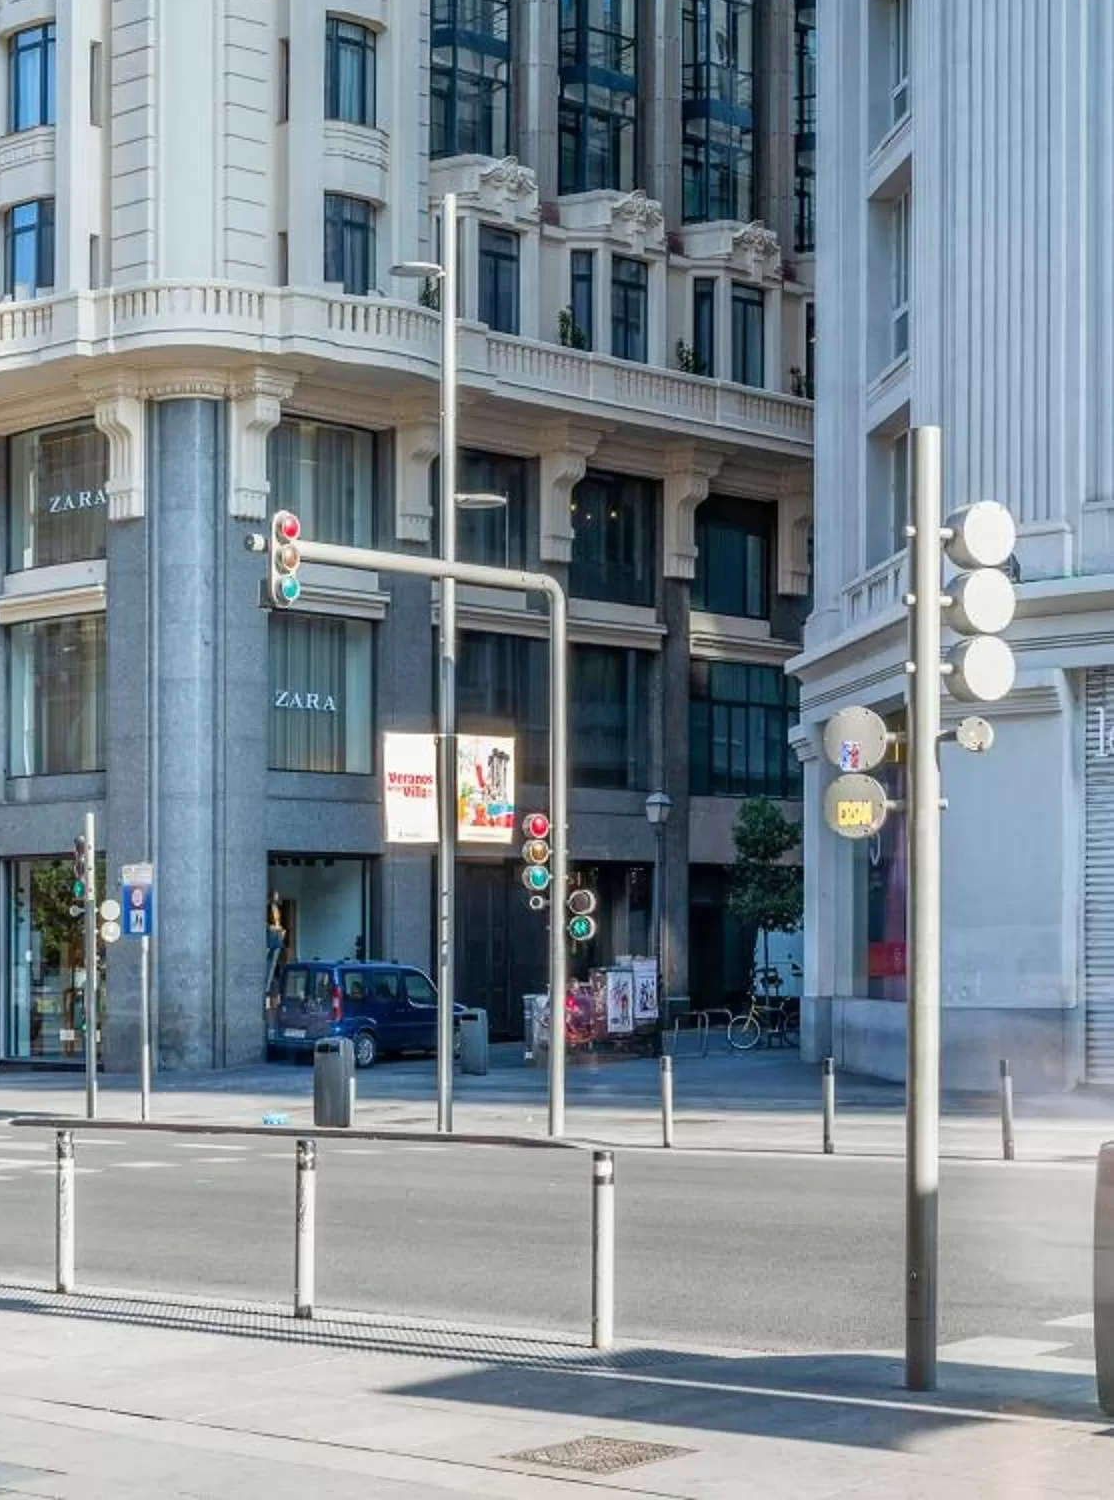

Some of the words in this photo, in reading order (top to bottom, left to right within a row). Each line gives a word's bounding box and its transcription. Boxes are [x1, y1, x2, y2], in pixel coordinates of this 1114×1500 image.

[49, 489, 106, 513] ZARA
[275, 690, 337, 711] ZARA
[388, 771, 434, 785] Veranos
